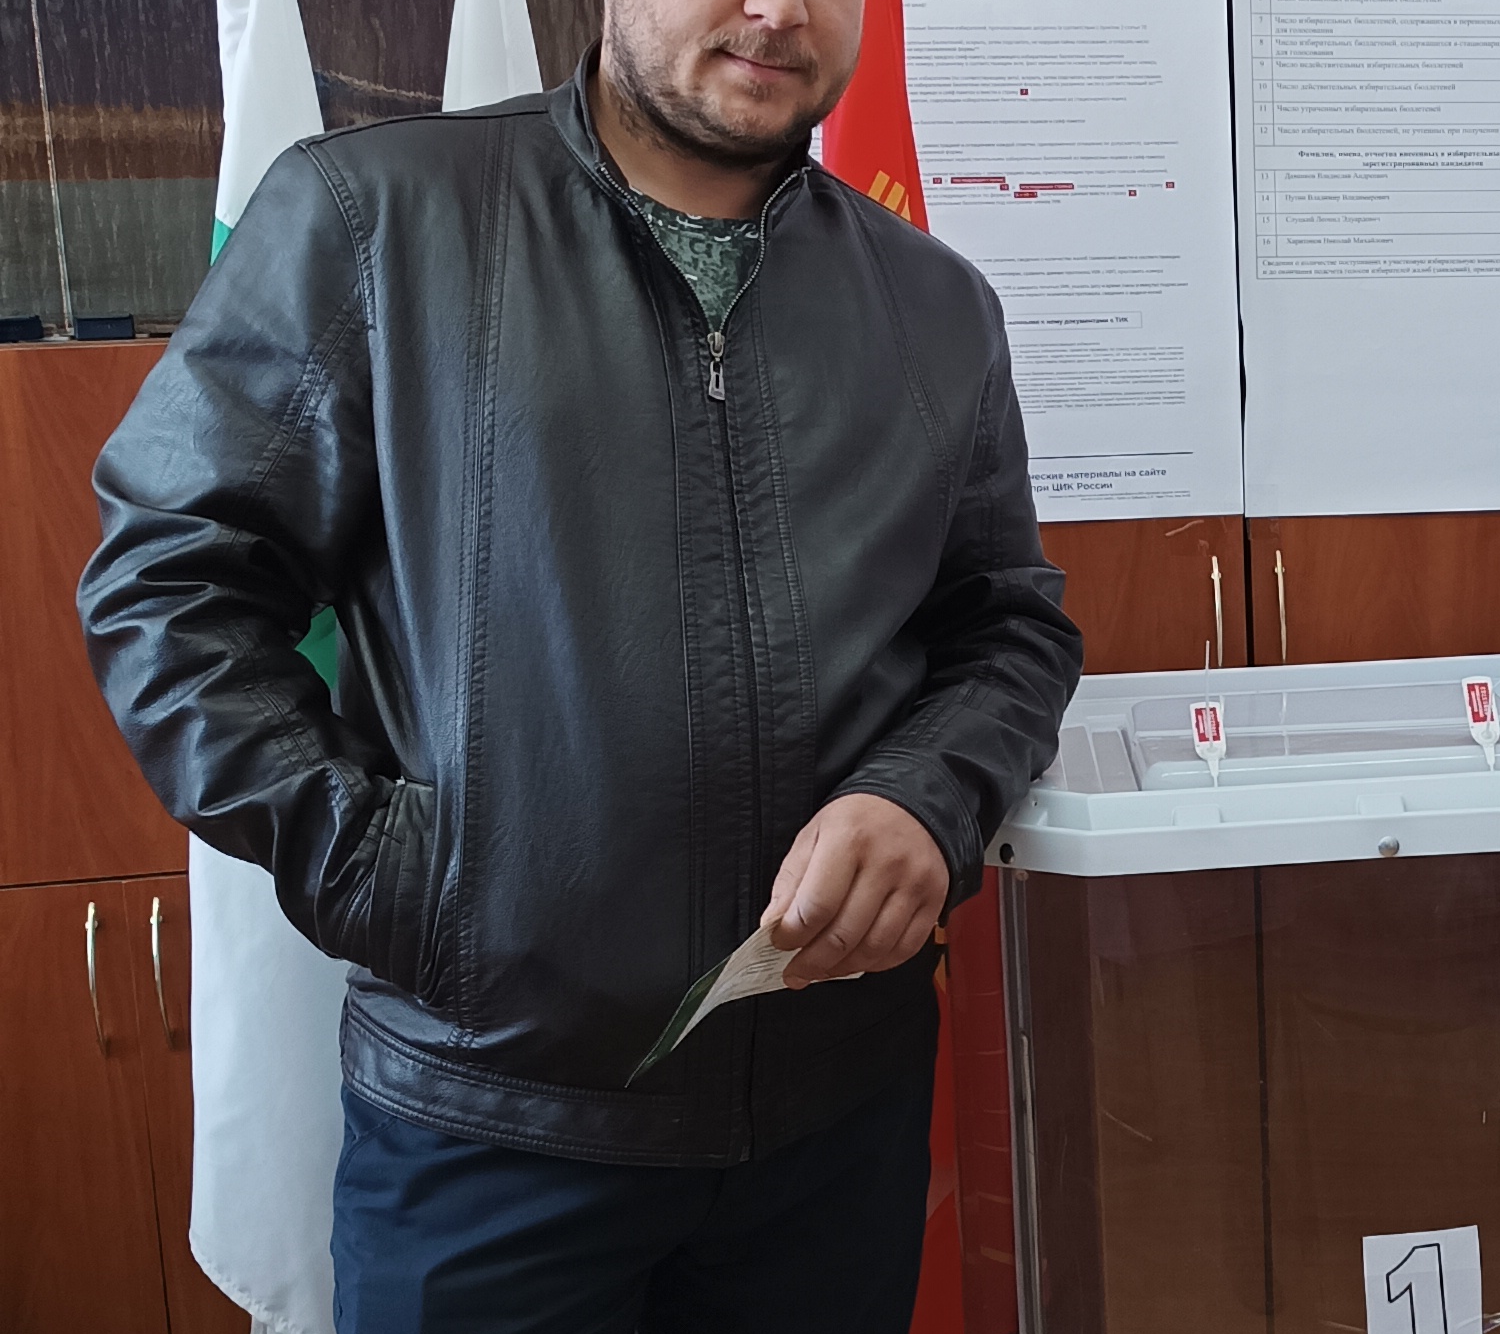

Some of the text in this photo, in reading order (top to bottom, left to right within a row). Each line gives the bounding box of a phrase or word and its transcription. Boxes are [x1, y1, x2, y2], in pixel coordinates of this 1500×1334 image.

[1030, 473, 1064, 481] ческие
[1067, 470, 1122, 479] материалы
[1139, 469, 1167, 477] сайте
[1052, 483, 1074, 492] ЦИК
[1077, 482, 1113, 490] России
